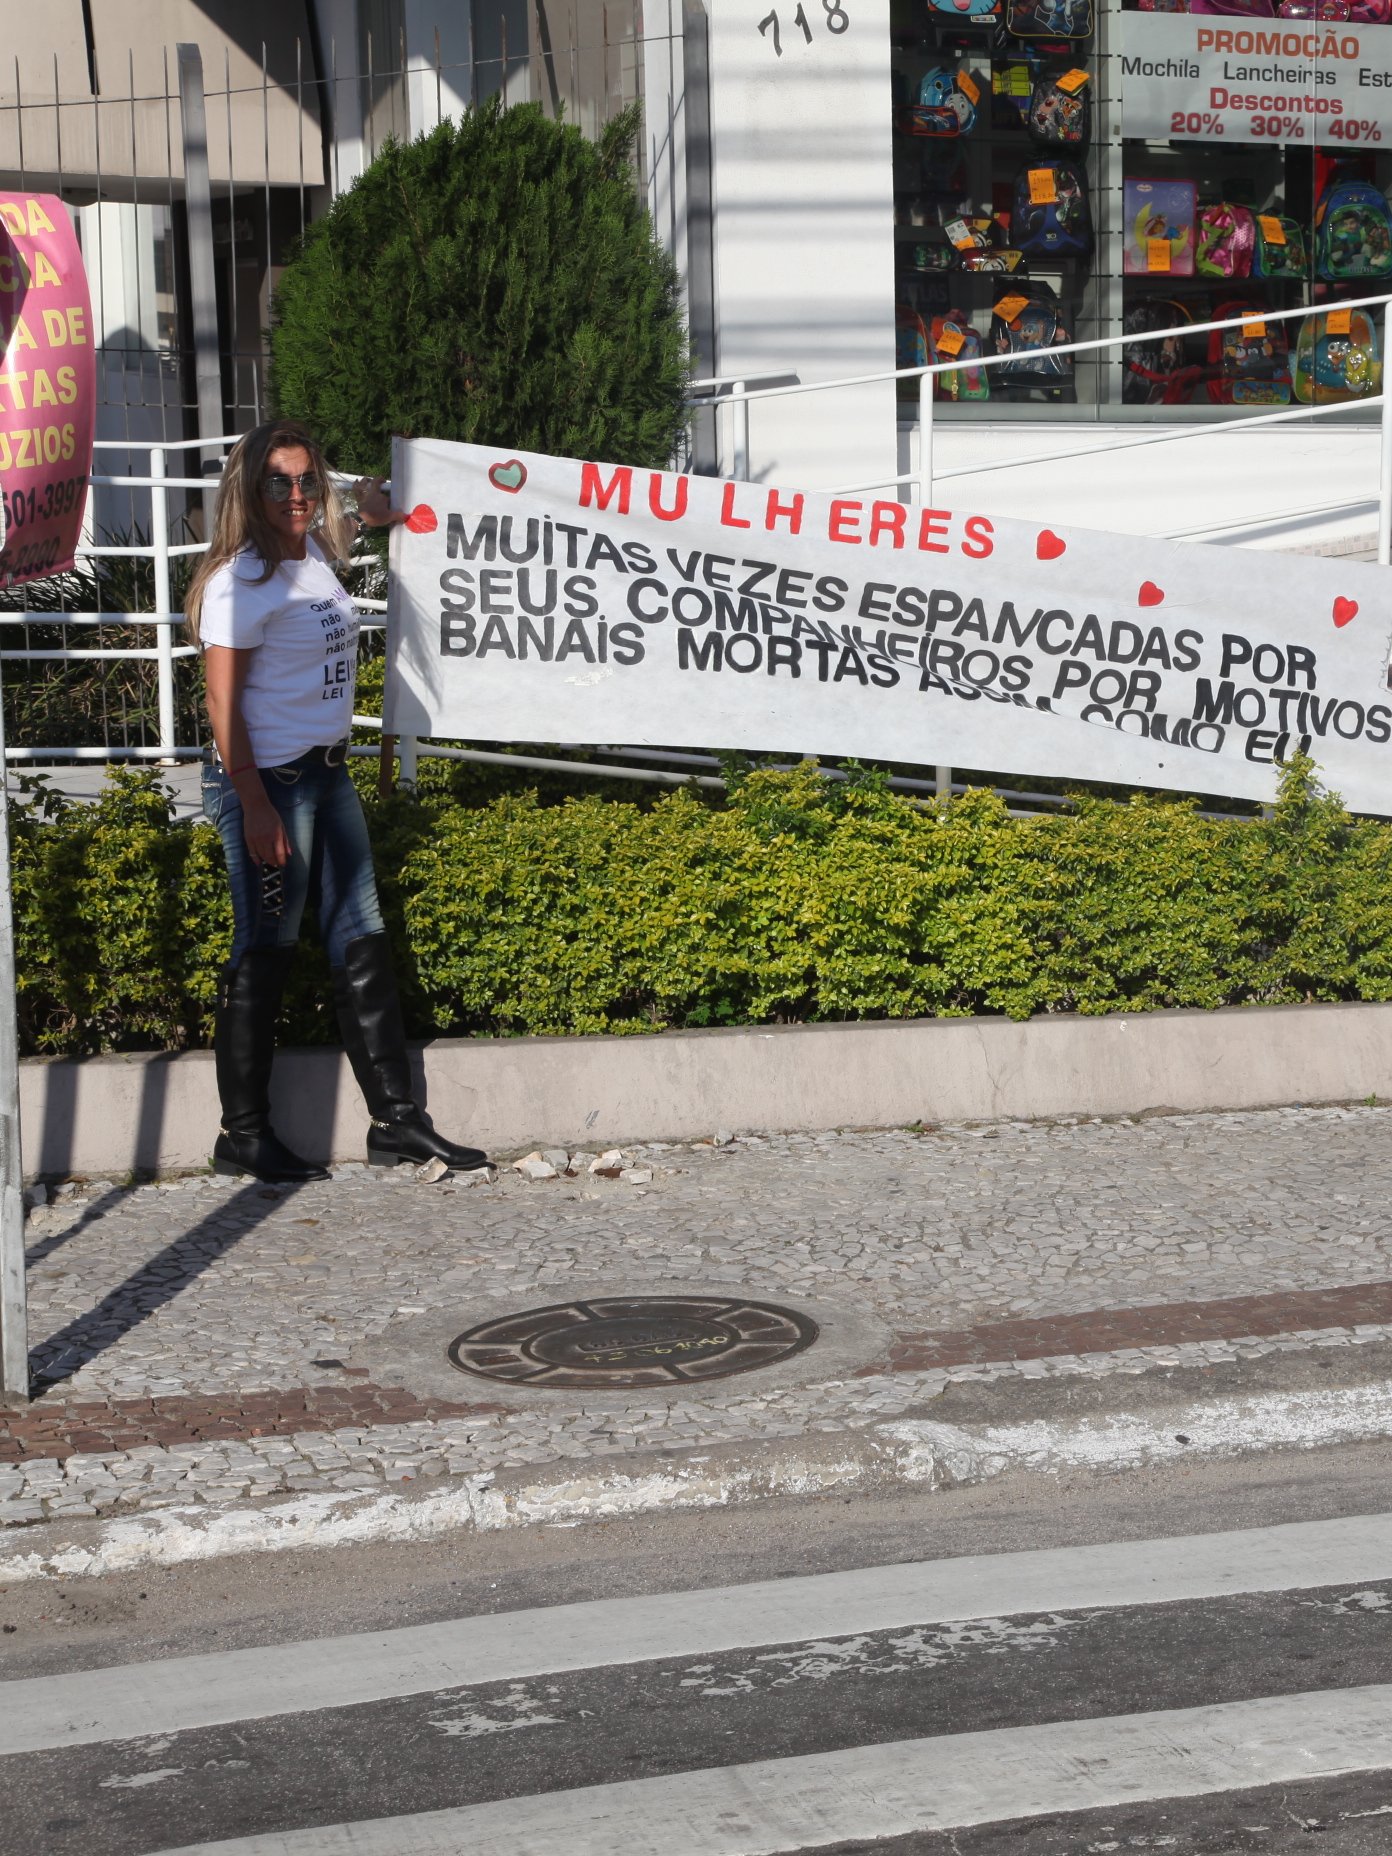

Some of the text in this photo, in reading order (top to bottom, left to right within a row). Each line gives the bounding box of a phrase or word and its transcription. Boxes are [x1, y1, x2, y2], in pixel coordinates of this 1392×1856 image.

[757, 0, 849, 57] 718
[1197, 29, 1359, 62] PROMOÇÃO
[1122, 57, 1199, 78] Mochila
[1224, 61, 1336, 85] Lancheiras
[1210, 87, 1343, 114] Descontos
[1171, 112, 1381, 141] 20% 30% 40%
[42, 307, 87, 348] DE
[0, 366, 77, 412] TAS
[579, 463, 994, 559] MULHERES
[310, 598, 338, 612] Quem
[446, 513, 1317, 690] MUITAS VEZES ESPANCADAS POR
[320, 614, 341, 628] não
[325, 628, 345, 642] não
[325, 643, 345, 655] não
[439, 567, 599, 618] SEUS
[1052, 660, 1162, 713] POR
[1192, 677, 1392, 743] MOTIVOS
[440, 611, 645, 665] BANAIS
[677, 627, 900, 688] MORTAS
[324, 660, 350, 686] LEI
[322, 686, 343, 700] LEI
